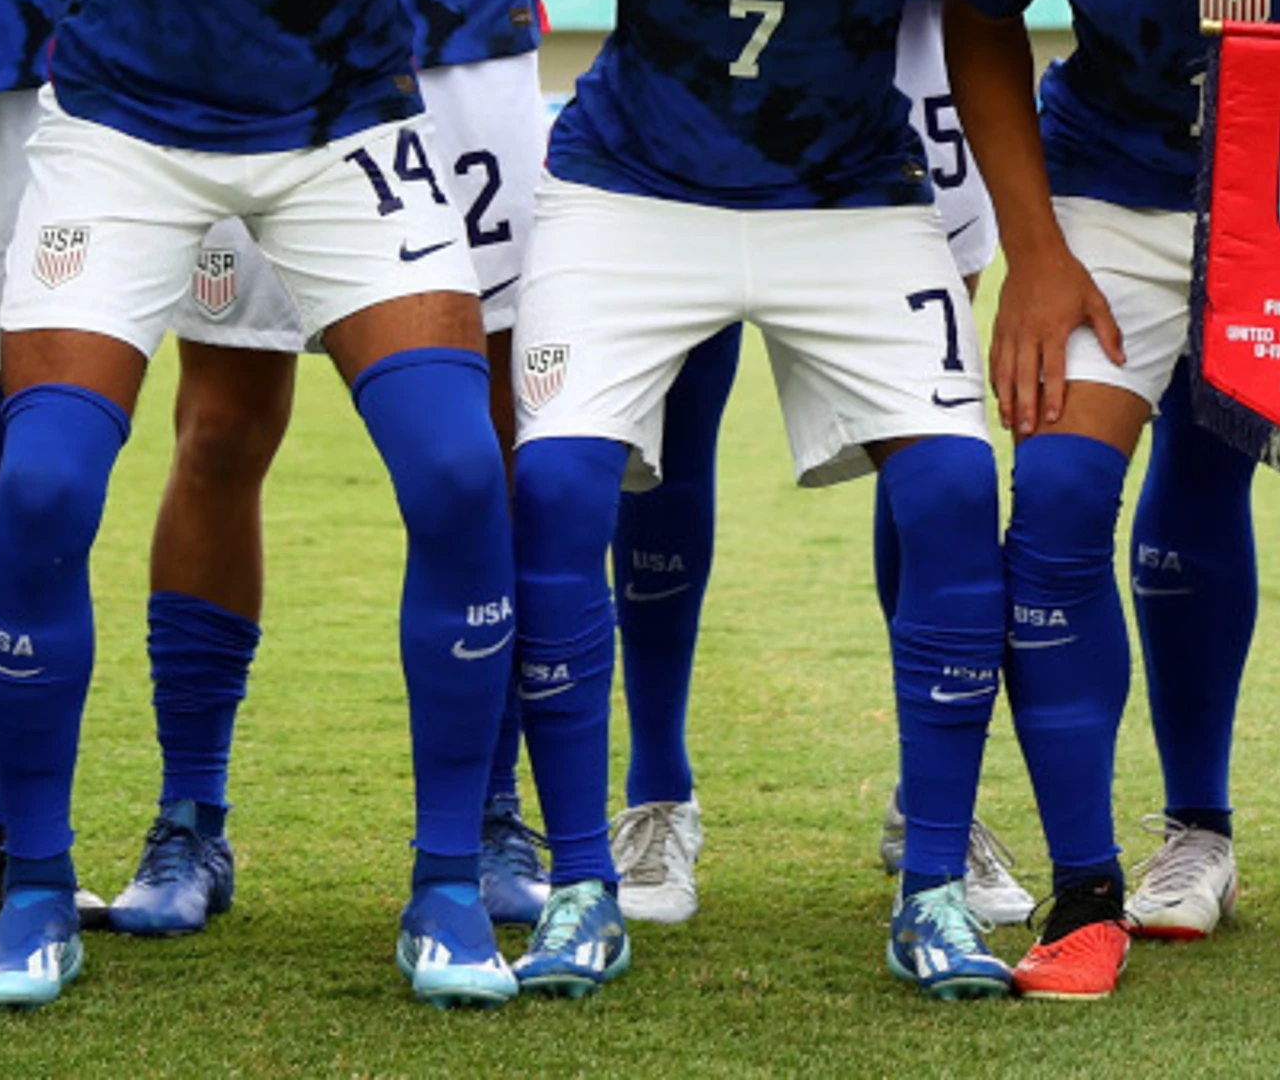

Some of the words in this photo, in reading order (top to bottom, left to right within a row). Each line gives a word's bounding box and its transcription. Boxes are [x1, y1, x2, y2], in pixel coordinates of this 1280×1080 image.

[923, 94, 968, 190] 5
[344, 127, 449, 217] 14
[454, 149, 514, 248] 2
[42, 228, 85, 252] USA
[198, 254, 235, 277] USA
[905, 288, 965, 373] 7
[1226, 325, 1274, 343] UNITED
[526, 350, 565, 374] USA
[632, 549, 686, 573] USA
[466, 595, 513, 626] USA
[1014, 605, 1068, 628] USA
